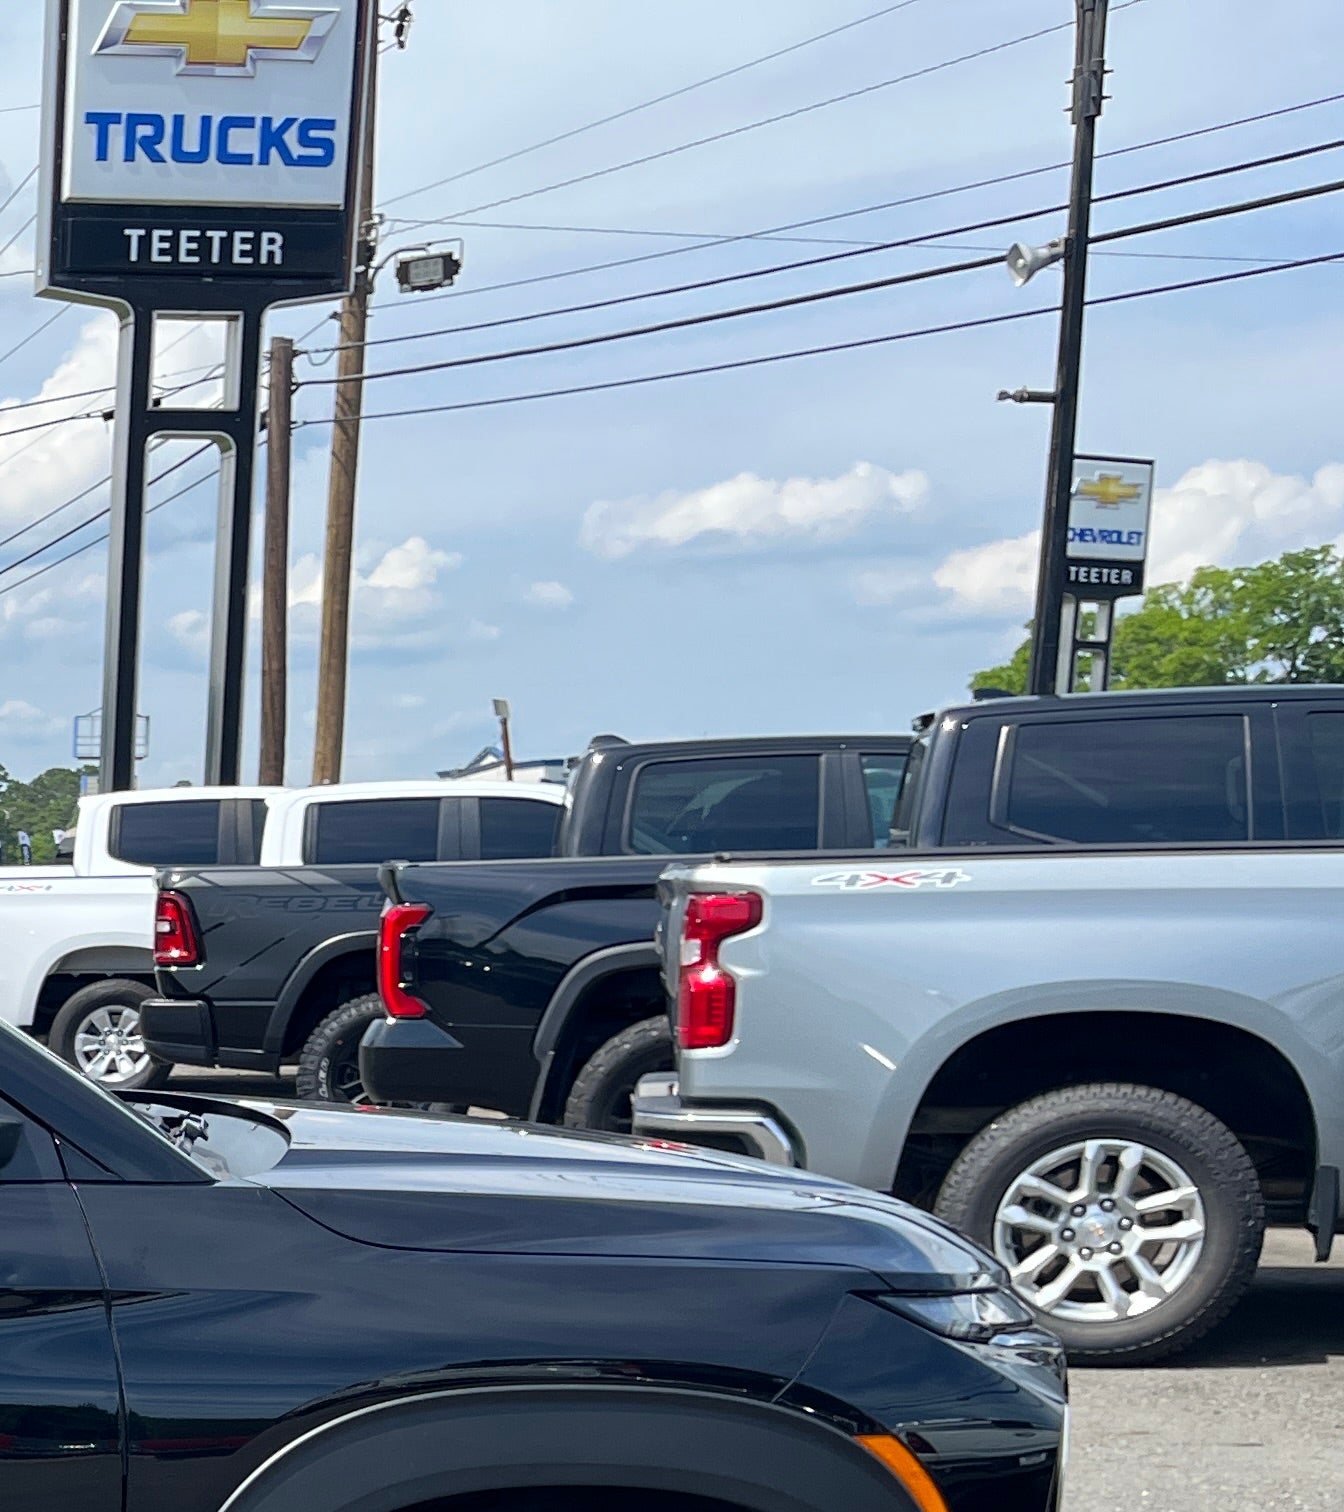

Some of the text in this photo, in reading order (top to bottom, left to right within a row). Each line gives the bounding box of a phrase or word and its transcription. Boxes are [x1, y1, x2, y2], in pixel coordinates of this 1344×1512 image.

[85, 111, 337, 168] TRUCKS
[123, 228, 285, 265] TEETER
[1068, 565, 1133, 585] TEETER
